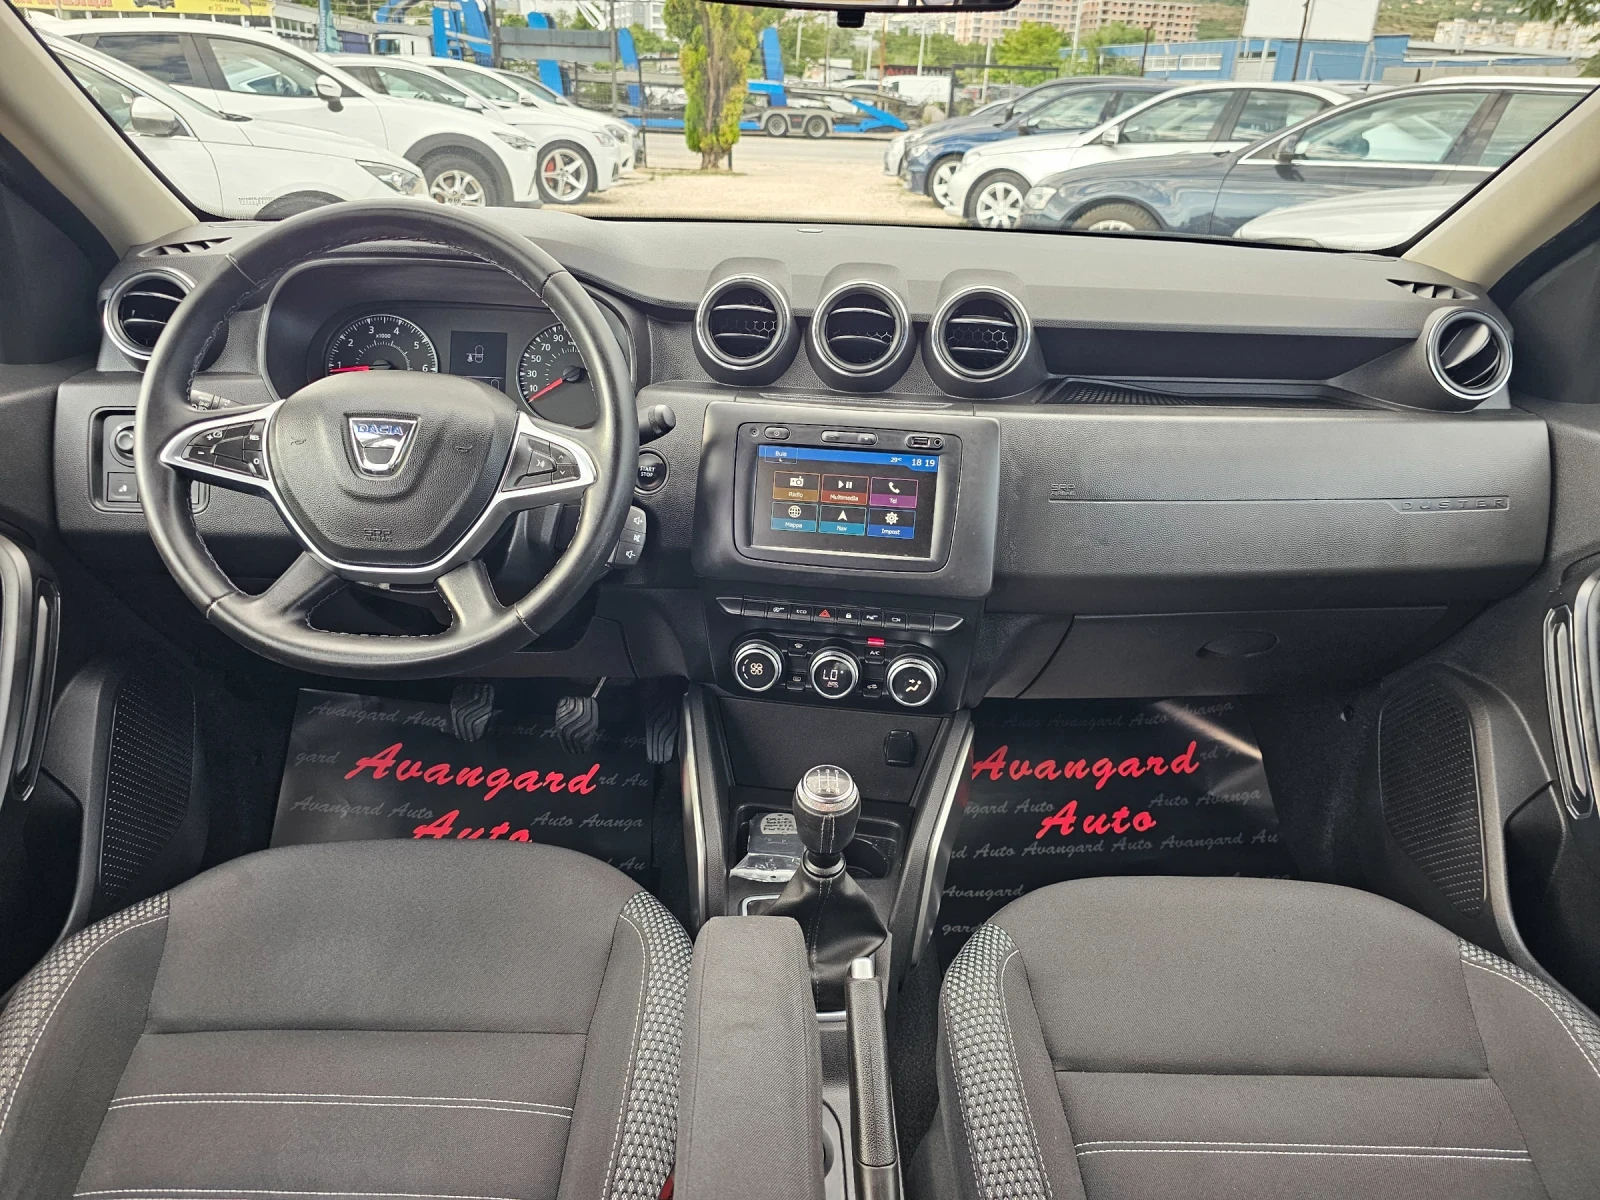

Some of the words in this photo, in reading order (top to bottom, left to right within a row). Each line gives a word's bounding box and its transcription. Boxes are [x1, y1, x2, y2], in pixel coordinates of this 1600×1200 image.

[368, 326, 374, 334] 3
[393, 327, 400, 335] 4
[347, 339, 354, 347] 2
[553, 334, 563, 342] 90
[413, 341, 419, 349] 5
[540, 343, 551, 351] 70
[422, 364, 428, 372] 6
[527, 370, 537, 378] 30
[529, 384, 538, 392] 10
[357, 424, 403, 435] DACIA
[911, 458, 922, 466] 18
[924, 459, 935, 467] 19
[1401, 499, 1505, 511] DUSTER
[308, 700, 401, 724] Avangard
[403, 710, 449, 728] Auto
[294, 751, 341, 767] gard
[971, 740, 1201, 791] Avangard
[343, 741, 602, 802] Avangard
[1014, 798, 1056, 815] Auto
[1147, 793, 1189, 809] Auto
[289, 795, 385, 820] Avangard
[387, 802, 435, 820] Auto
[531, 811, 575, 828] Auto
[579, 813, 645, 832] Avanga
[1036, 800, 1157, 839] Auto
[973, 843, 1016, 860] Auto
[1021, 840, 1105, 858] Avangard
[1111, 836, 1153, 852] Auto
[1160, 832, 1244, 850] Avangard
